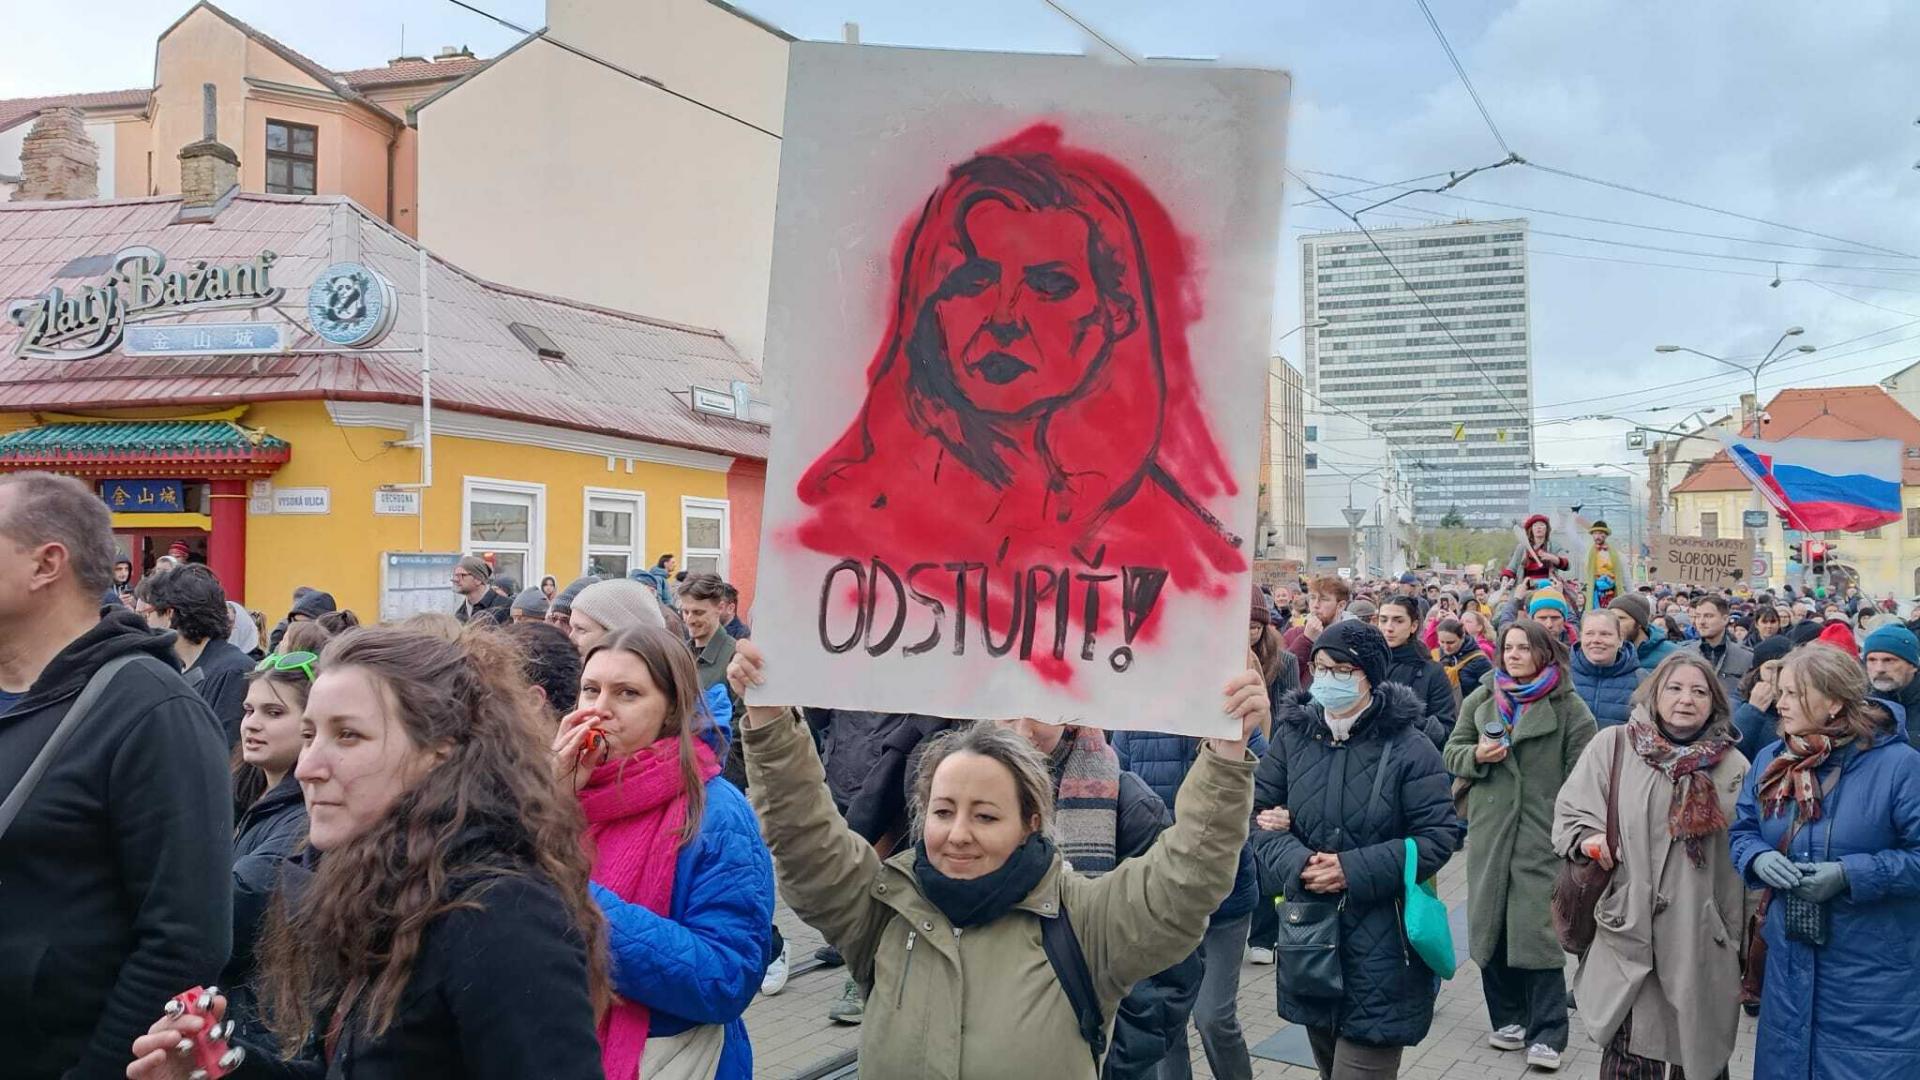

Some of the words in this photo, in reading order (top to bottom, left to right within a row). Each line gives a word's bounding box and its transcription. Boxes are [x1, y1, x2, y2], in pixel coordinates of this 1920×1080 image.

[110, 245, 284, 310] Bažant
[151, 331, 255, 350] 金山城
[112, 486, 178, 511] 金山城
[818, 536, 1169, 673] ODSTÚPIŤ!
